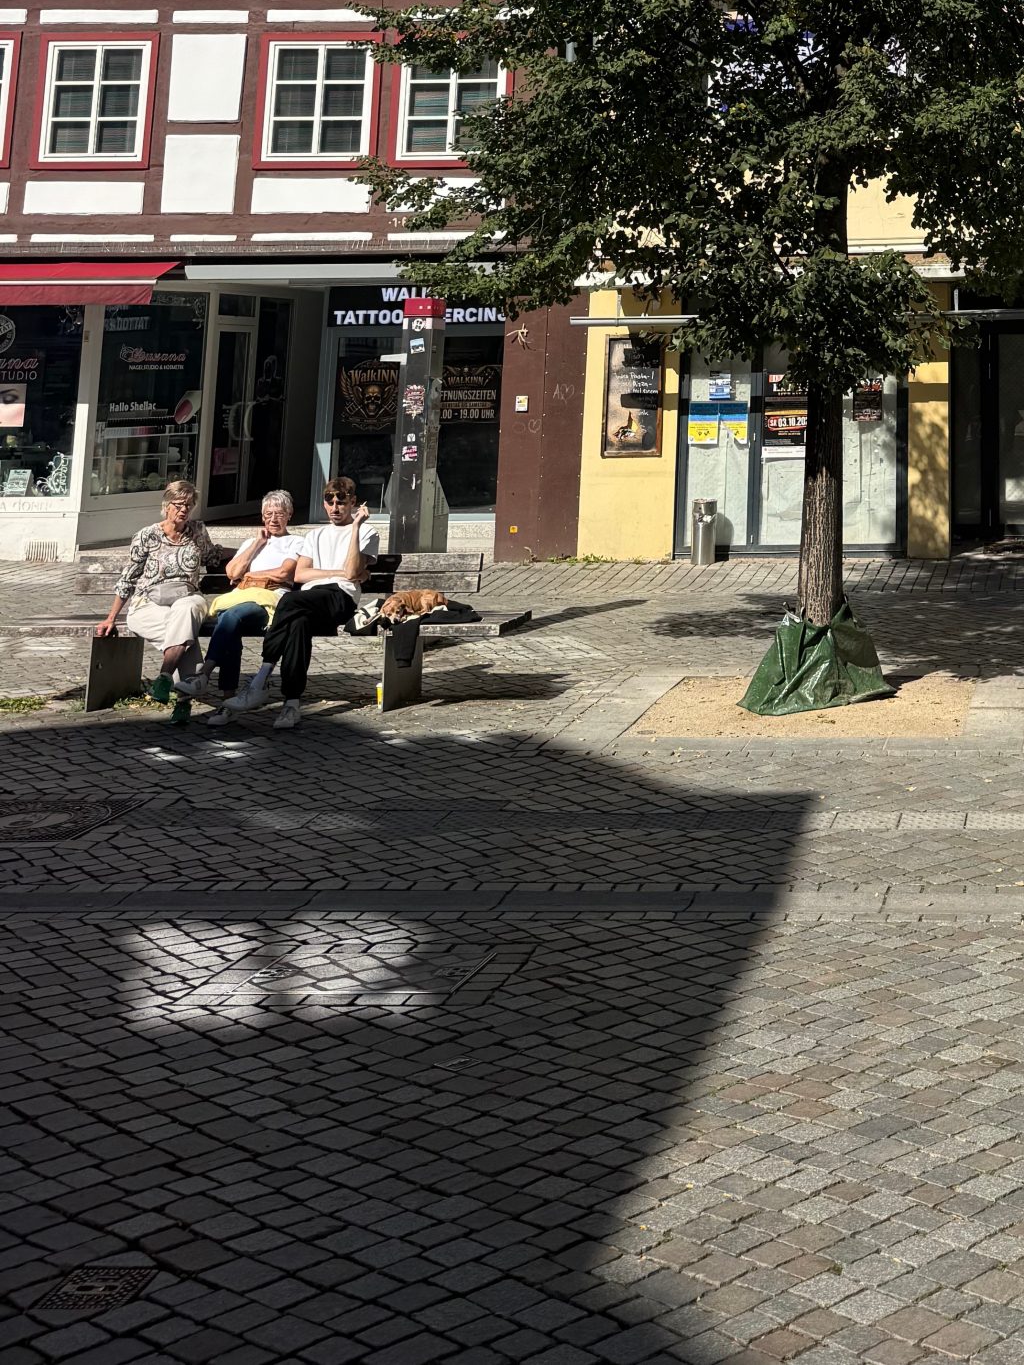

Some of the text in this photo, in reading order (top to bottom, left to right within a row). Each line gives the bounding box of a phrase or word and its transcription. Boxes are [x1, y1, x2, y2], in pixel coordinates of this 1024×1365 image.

[334, 309, 404, 326] TATTOO
[443, 307, 507, 323] ERCIN
[0, 371, 37, 380] TUDIO
[348, 369, 398, 385] WalkINN
[440, 389, 497, 401] FFNUNGSZEITEN
[109, 400, 157, 412] Hallo Shellac
[481, 408, 495, 419] UHR
[778, 416, 808, 428] 03.10.20
